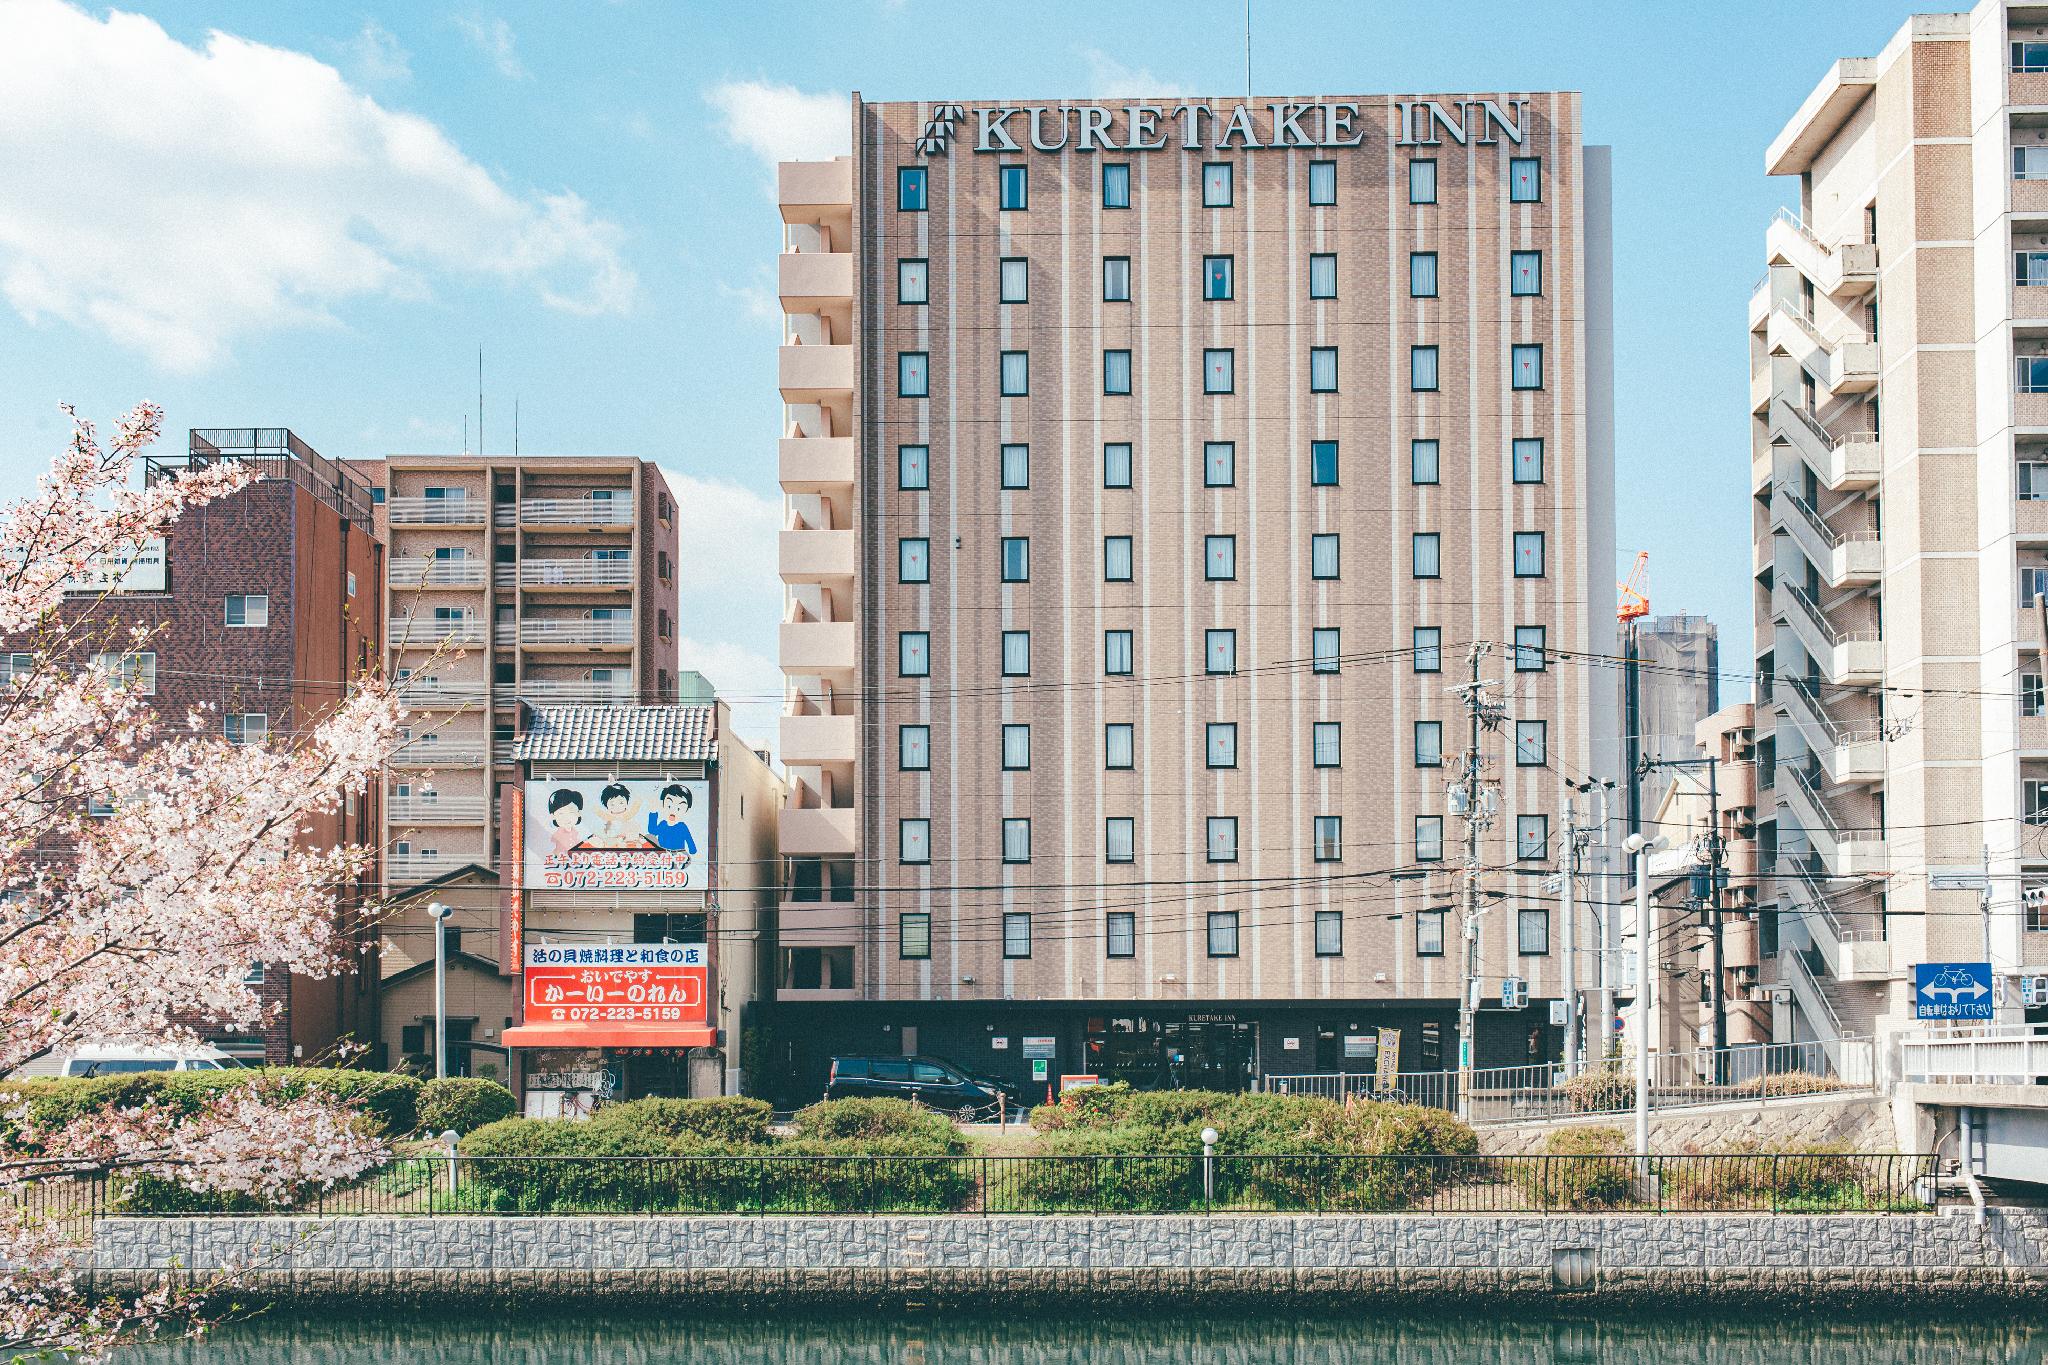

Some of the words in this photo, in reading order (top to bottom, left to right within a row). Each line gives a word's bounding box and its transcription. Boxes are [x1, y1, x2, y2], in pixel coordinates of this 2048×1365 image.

[972, 101, 1365, 152] KURETAKE
[1395, 99, 1530, 147] INN
[544, 853, 687, 869] 正午より電話予約受付中
[564, 871, 688, 887] 072-223-5159
[532, 948, 699, 964] 活の貝焼料理と和食の店
[580, 968, 653, 984] おいでやす
[545, 984, 687, 1003] かーいーのれん
[570, 1007, 681, 1021] 072-223-5159
[1188, 1014, 1223, 1022] KURETAKE
[1224, 1014, 1236, 1022] INN
[1918, 1003, 1991, 1017] 自転車はおりて下さい
[1382, 1050, 1391, 1089] EXCHANG
